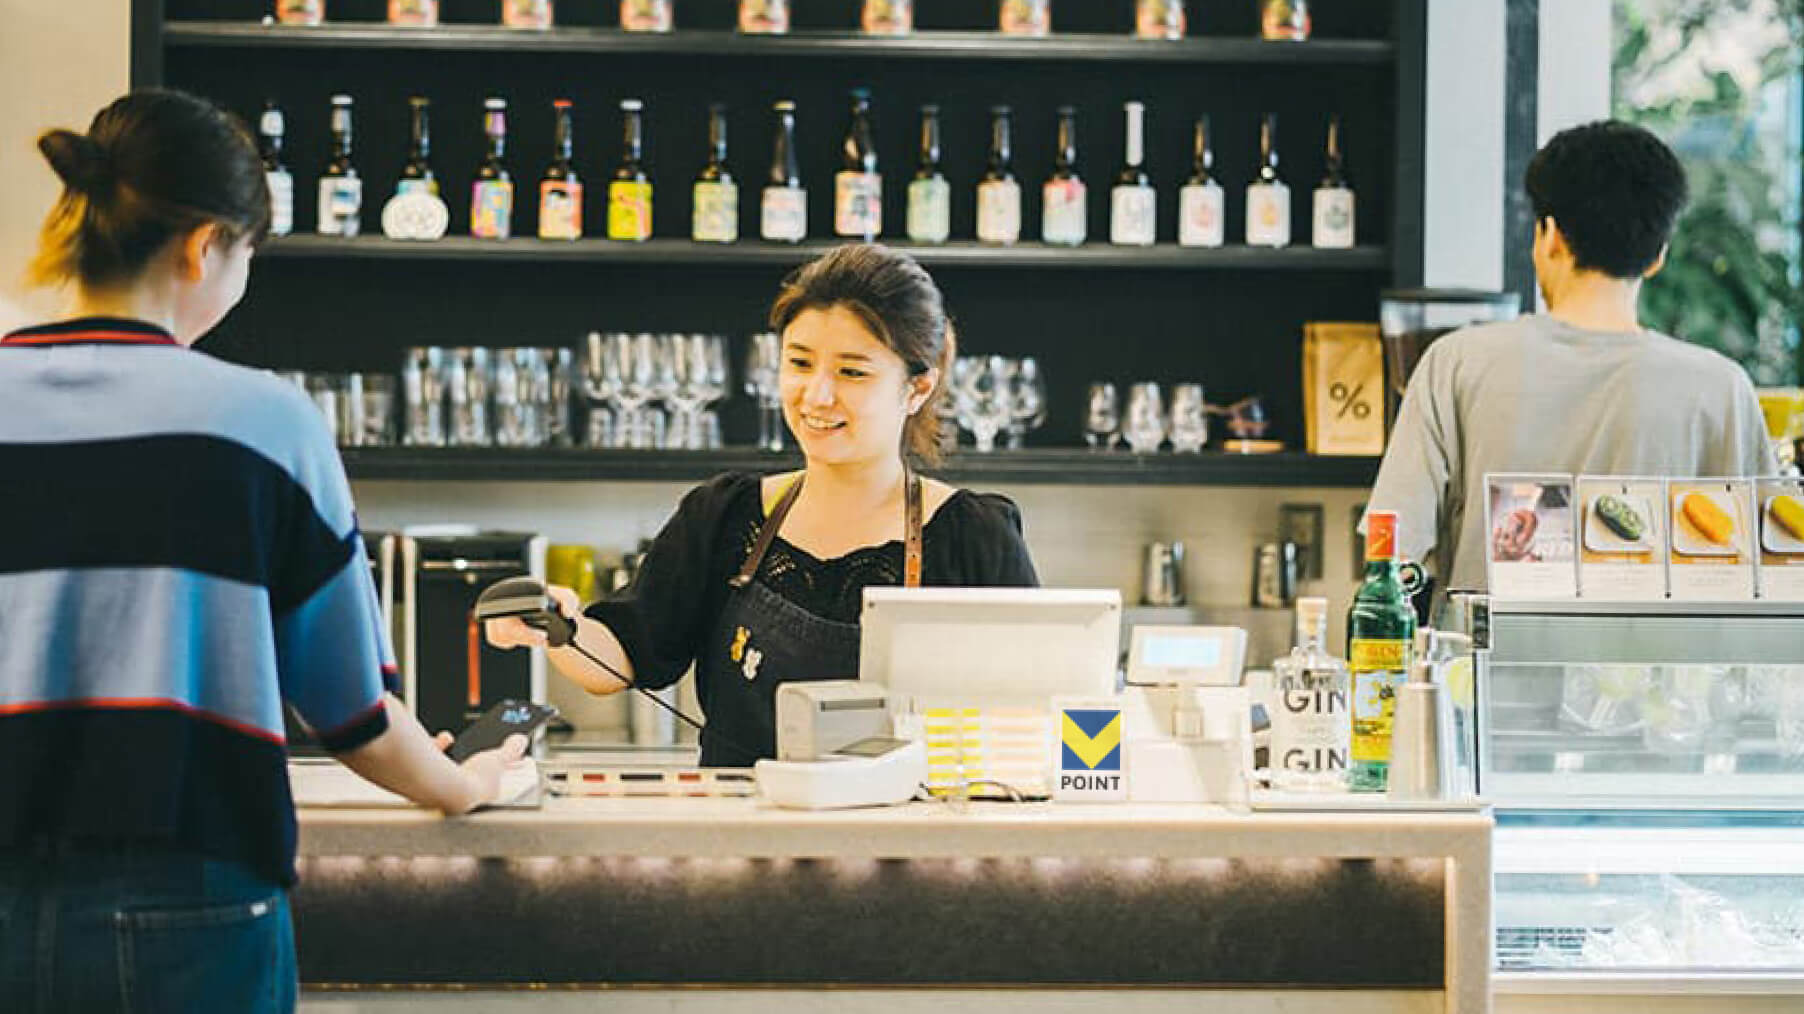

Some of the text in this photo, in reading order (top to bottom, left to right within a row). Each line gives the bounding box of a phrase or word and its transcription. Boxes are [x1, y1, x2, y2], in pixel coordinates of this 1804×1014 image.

[1284, 688, 1346, 713] GIN
[1284, 748, 1346, 772] GIN
[1061, 775, 1121, 791] POINT
